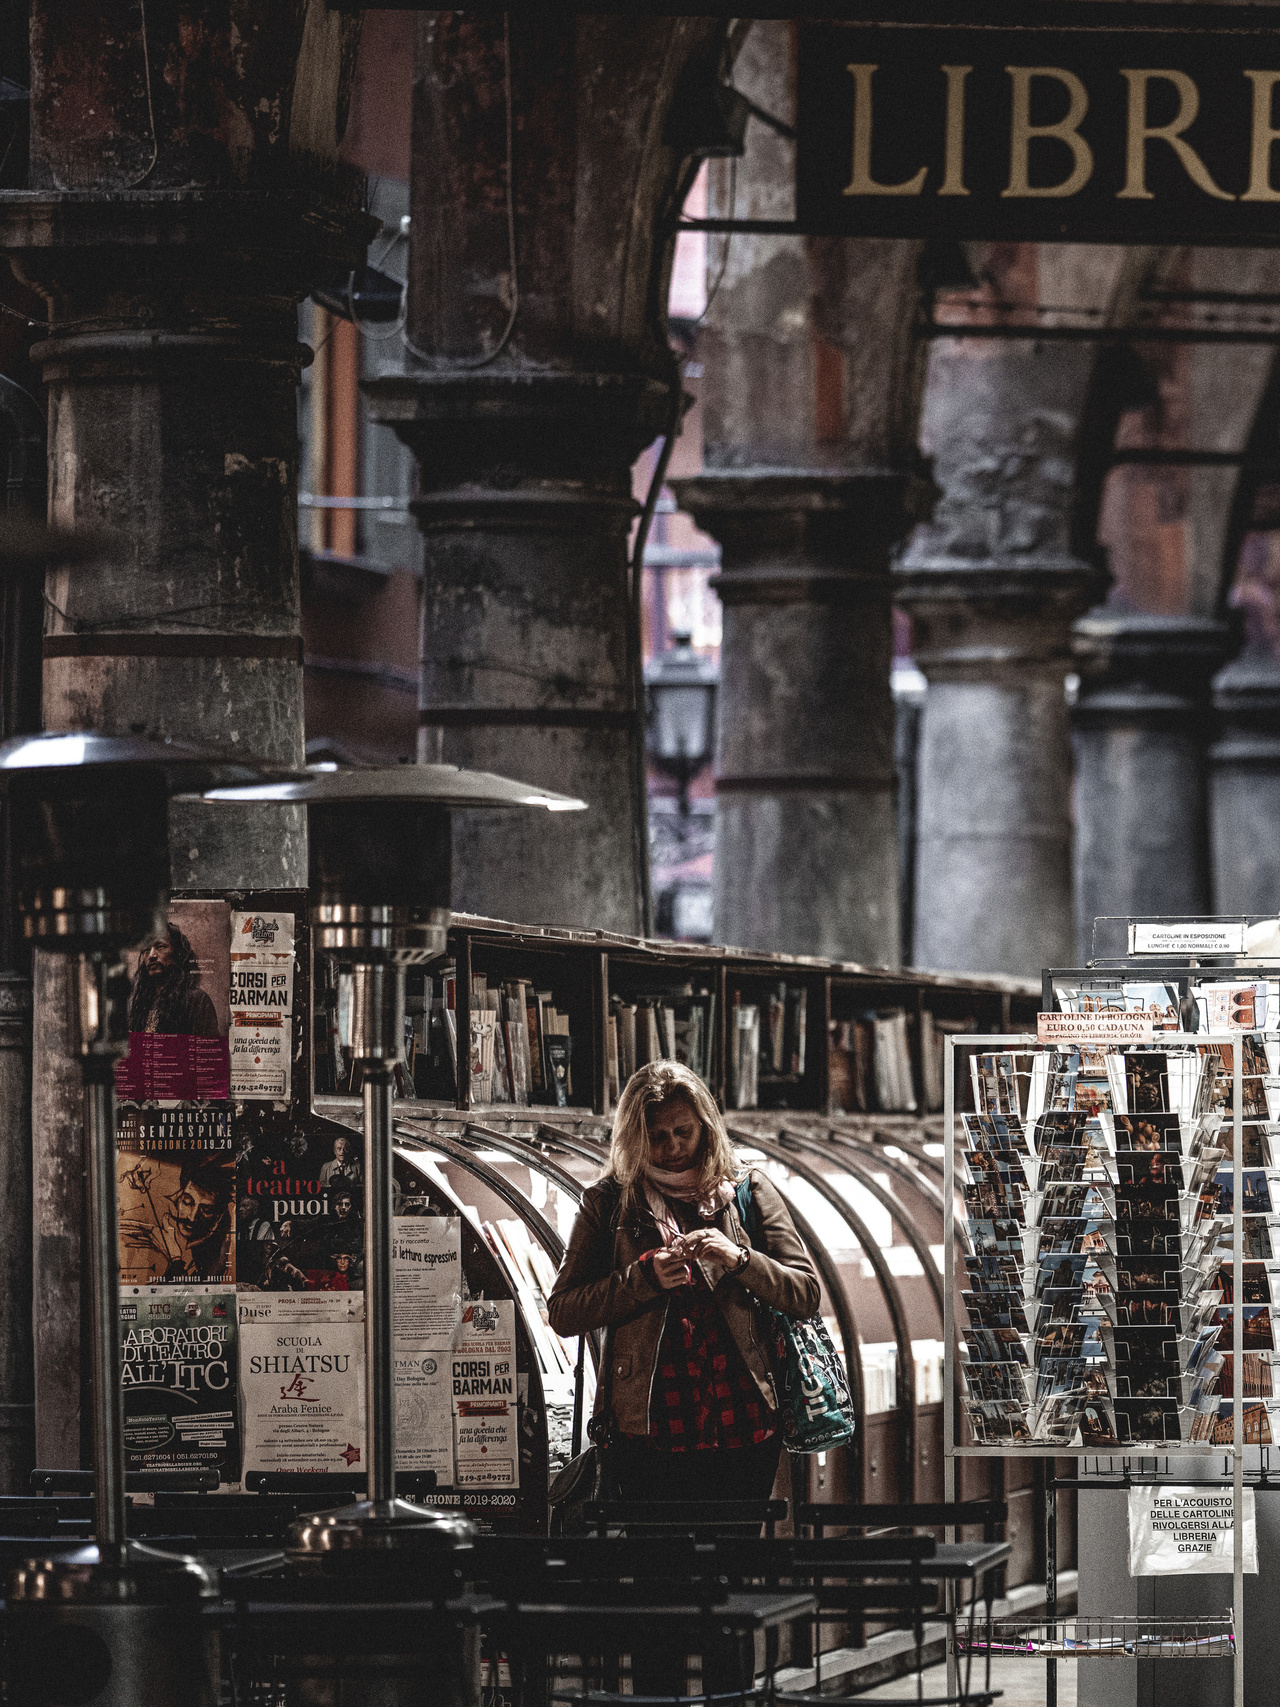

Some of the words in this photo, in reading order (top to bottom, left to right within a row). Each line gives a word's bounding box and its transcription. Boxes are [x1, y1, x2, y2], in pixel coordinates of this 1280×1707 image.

[230, 972, 267, 988] CORSI
[271, 975, 286, 987] PER
[229, 990, 288, 1006] BARMAN
[1039, 1013, 1093, 1021] CARTOLINE
[1107, 1013, 1153, 1021] BOLOGNA
[1047, 1023, 1075, 1032] EURO
[1077, 1024, 1095, 1033] 0,50
[1098, 1023, 1145, 1032] CADAUNA
[248, 1037, 268, 1046] goccia
[269, 1037, 281, 1045] che
[231, 1045, 240, 1055] fa
[241, 1045, 248, 1053] la
[140, 1125, 232, 1138] SENZASPINE
[140, 1139, 187, 1150] STAGIONE
[272, 1160, 286, 1175] a
[247, 1176, 322, 1196] teatro
[272, 1193, 330, 1223] puoi
[399, 1246, 422, 1262] lettura
[424, 1250, 457, 1267] espressiva
[148, 1303, 171, 1315] ITC
[239, 1306, 272, 1318] Duse
[276, 1337, 323, 1347] SCUOLA
[121, 1345, 143, 1362] DI
[143, 1340, 223, 1362] TEATRO
[250, 1355, 351, 1374] SHIATSU
[452, 1361, 490, 1378] CORSI
[494, 1362, 510, 1375] PER
[121, 1360, 230, 1391] ALL'ITC
[453, 1378, 512, 1396] BARMAN
[270, 1404, 299, 1414] Araba
[300, 1404, 332, 1413] Fenice
[459, 1427, 473, 1435] una
[474, 1427, 495, 1437] goccia
[495, 1425, 507, 1434] che
[466, 1435, 473, 1443] la
[464, 1494, 516, 1506] 2019-2020
[1154, 1499, 1172, 1507] PER
[1175, 1498, 1232, 1507] L'ACQUISTO
[1150, 1510, 1180, 1519] DELLE
[1182, 1509, 1234, 1518] CARTOLINE
[1152, 1521, 1209, 1530] RIVOLGERSI
[1211, 1520, 1234, 1529] ALLA
[1173, 1532, 1217, 1541] LIBRERIA
[1177, 1544, 1212, 1552] GRAZIE
